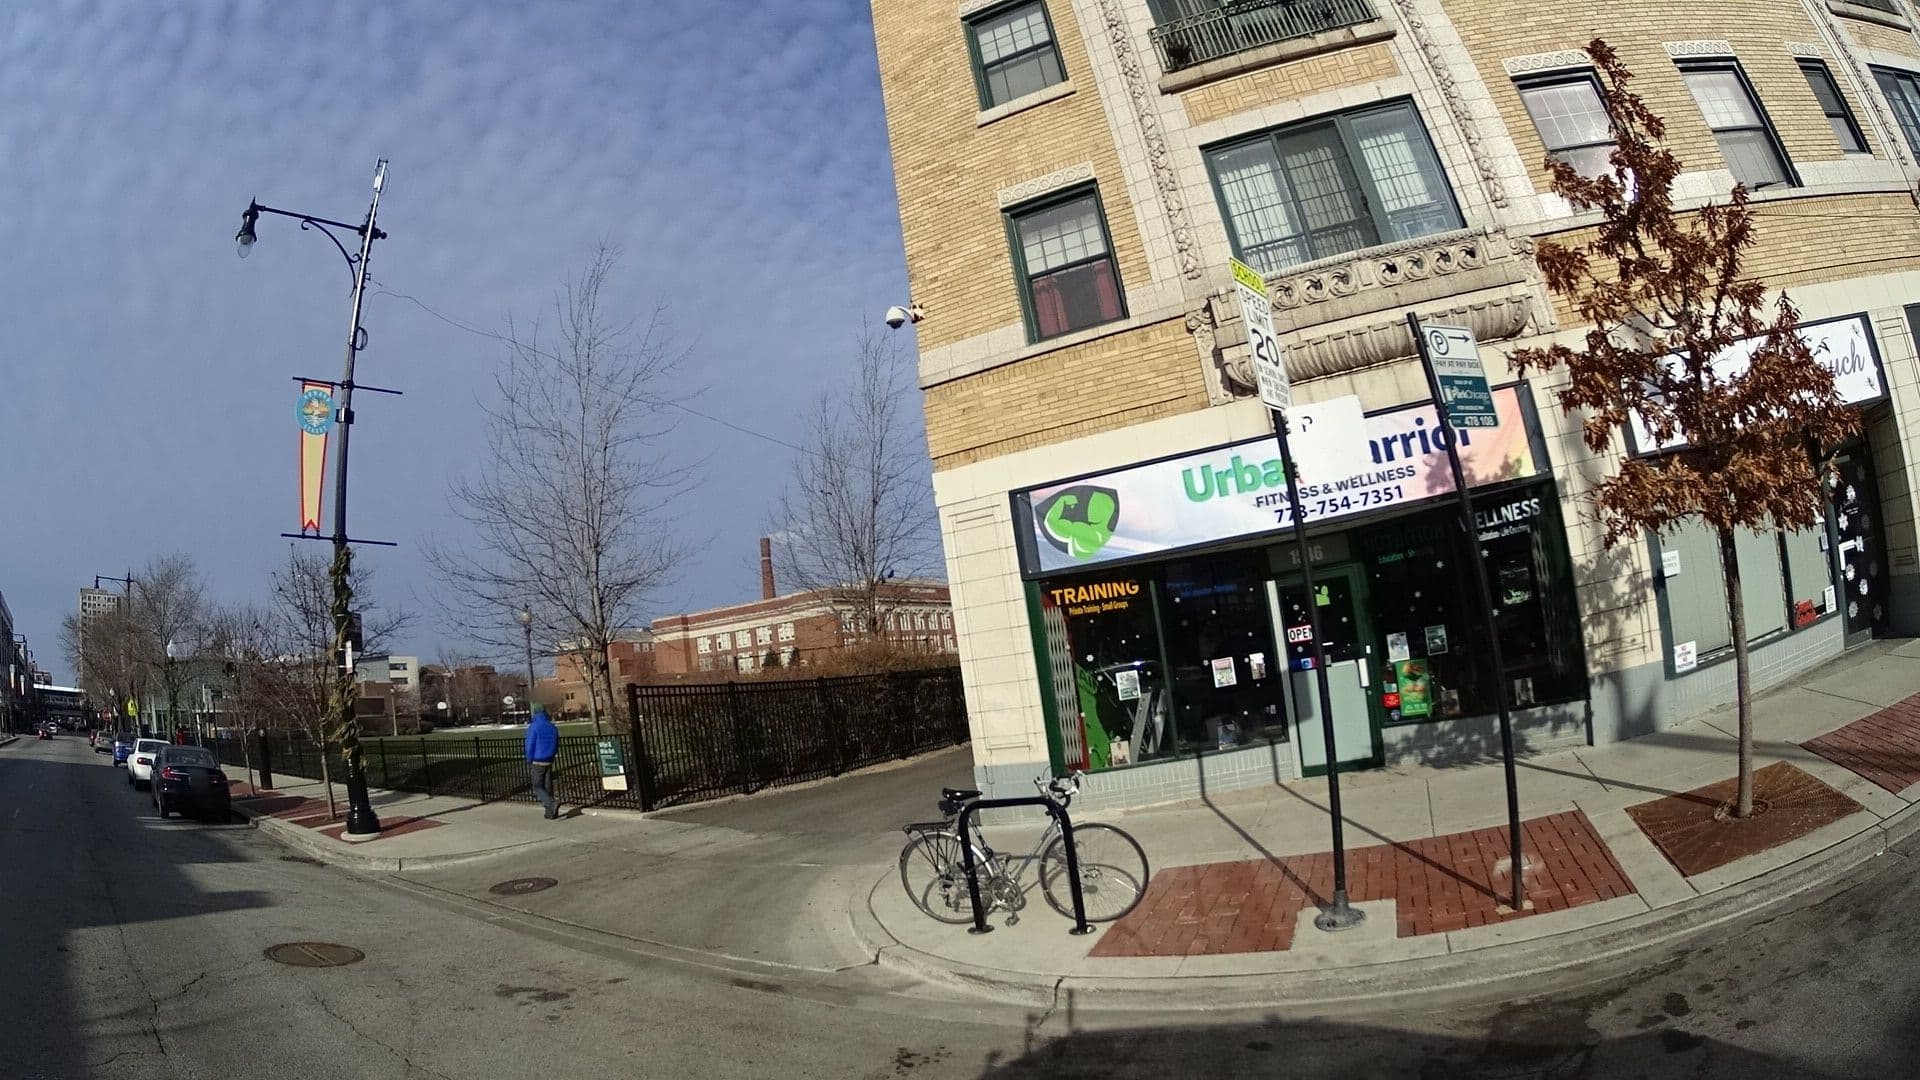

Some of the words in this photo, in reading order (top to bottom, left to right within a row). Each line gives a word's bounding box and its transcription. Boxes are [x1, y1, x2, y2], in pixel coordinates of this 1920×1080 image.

[1232, 262, 1264, 293] SCHOOL
[1240, 288, 1269, 315] SPEED
[1246, 306, 1270, 332] LIMIT
[1251, 328, 1279, 367] 20
[1820, 337, 1865, 377] uch
[1435, 360, 1446, 368] PAY
[1447, 360, 1455, 368] AT
[1456, 361, 1467, 369] PAY
[1182, 455, 1287, 502] Urba
[1255, 485, 1319, 508] FITNSS
[1322, 482, 1334, 494] &
[1335, 465, 1416, 491] WELLNESS
[1459, 498, 1540, 532] ELLNESS
[1051, 582, 1139, 606] TRAINING
